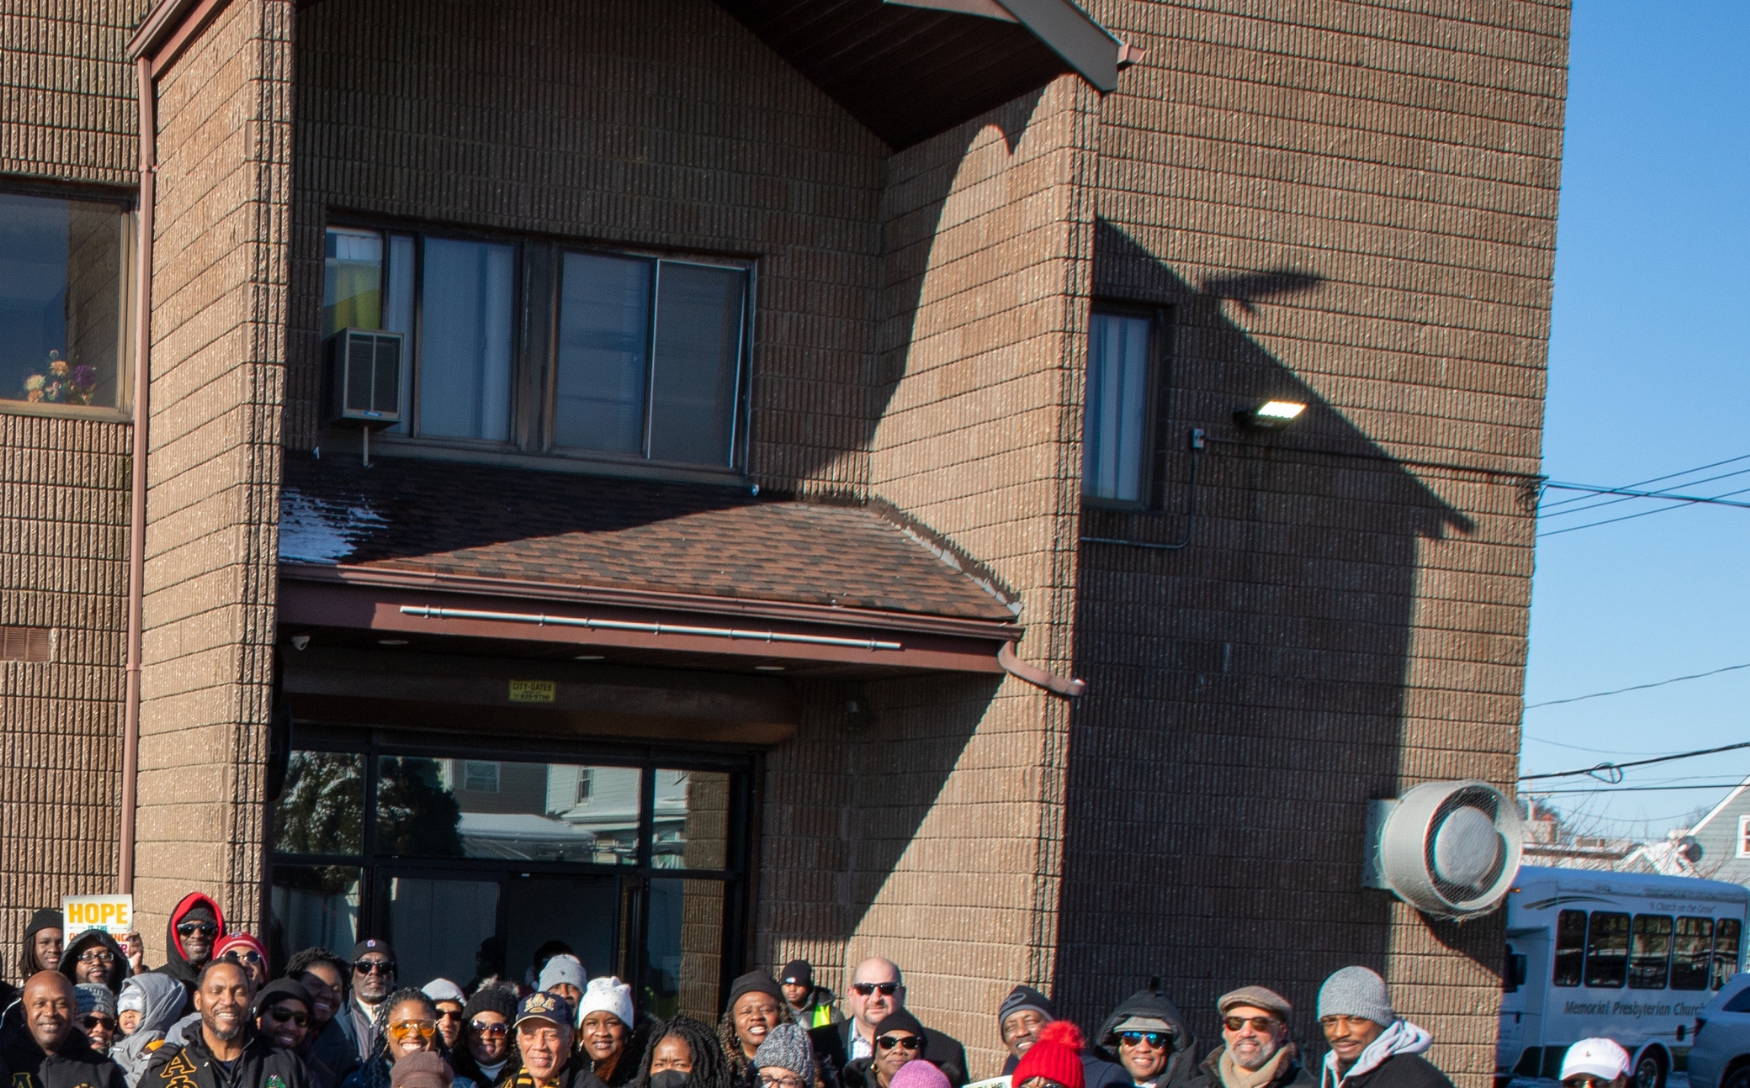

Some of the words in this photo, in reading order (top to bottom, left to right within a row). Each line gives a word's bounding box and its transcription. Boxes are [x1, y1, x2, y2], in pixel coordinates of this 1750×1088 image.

[68, 903, 128, 924] HOPE
[1564, 1000, 1609, 1015] Memorial
[1612, 1001, 1670, 1019] Presbyterian
